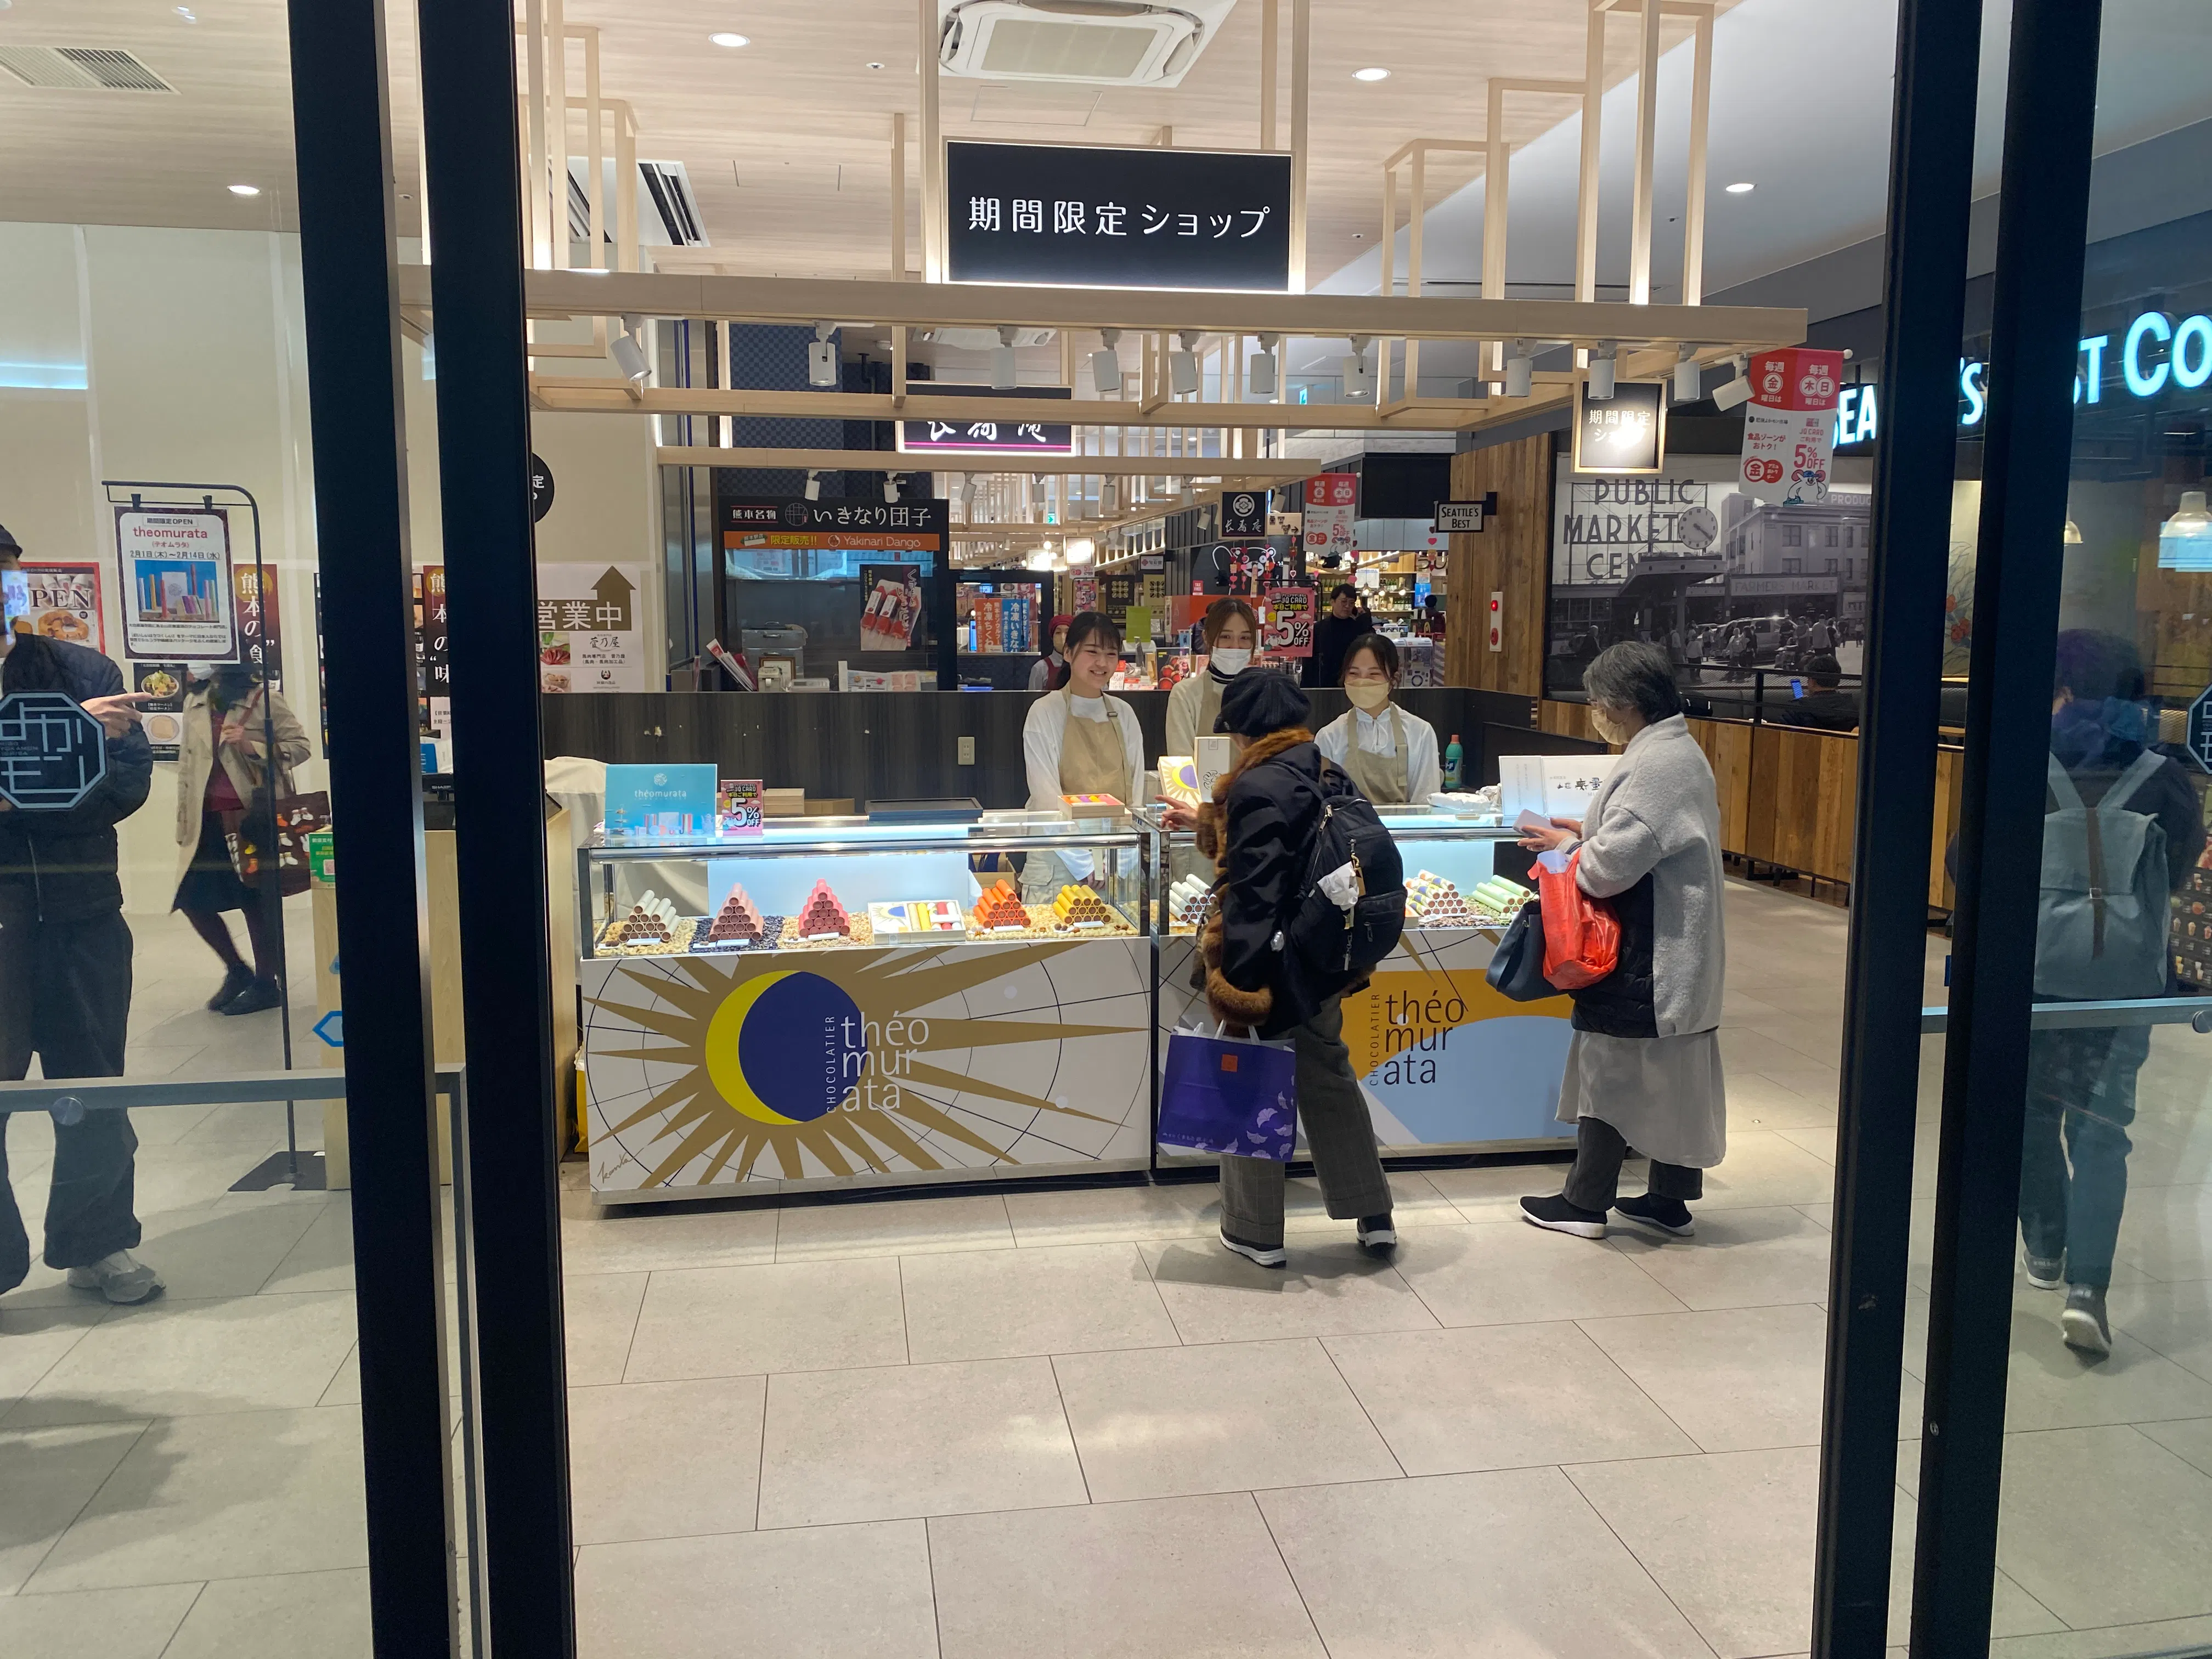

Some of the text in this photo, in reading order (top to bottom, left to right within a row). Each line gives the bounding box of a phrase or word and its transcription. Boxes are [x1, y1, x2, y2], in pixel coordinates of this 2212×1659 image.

[968, 196, 1271, 238] 期間限定ショップ
[1765, 361, 1785, 373] 毎週
[1809, 365, 1829, 376] 毎週
[1760, 394, 1782, 403] 曜日は
[1805, 398, 1826, 406] 曜日は
[1747, 432, 1786, 442] 食品ゾーンが
[1807, 459, 1826, 469] OFF
[1595, 479, 1694, 505] PUBLIC
[732, 509, 776, 520] 熊本名物
[813, 506, 932, 527] いきなり団子
[1441, 506, 1479, 518] SEATTLE'S
[1452, 518, 1471, 528] BEST
[1564, 514, 1679, 544] MARKET
[133, 526, 208, 538] theomurata
[886, 536, 921, 549] Dango
[1792, 580, 1834, 591] MARKET
[538, 601, 622, 630] 営業中
[1294, 637, 1308, 646] OFF
[1385, 990, 1464, 1025] théo
[840, 1010, 929, 1049] théo
[1369, 994, 1380, 1086] CHOCOLATIER
[1386, 1026, 1453, 1053] mur
[825, 1016, 837, 1113] CHOCOLATIER
[843, 1048, 917, 1078] mur
[1384, 1054, 1436, 1085] ata
[842, 1078, 900, 1112] ata
